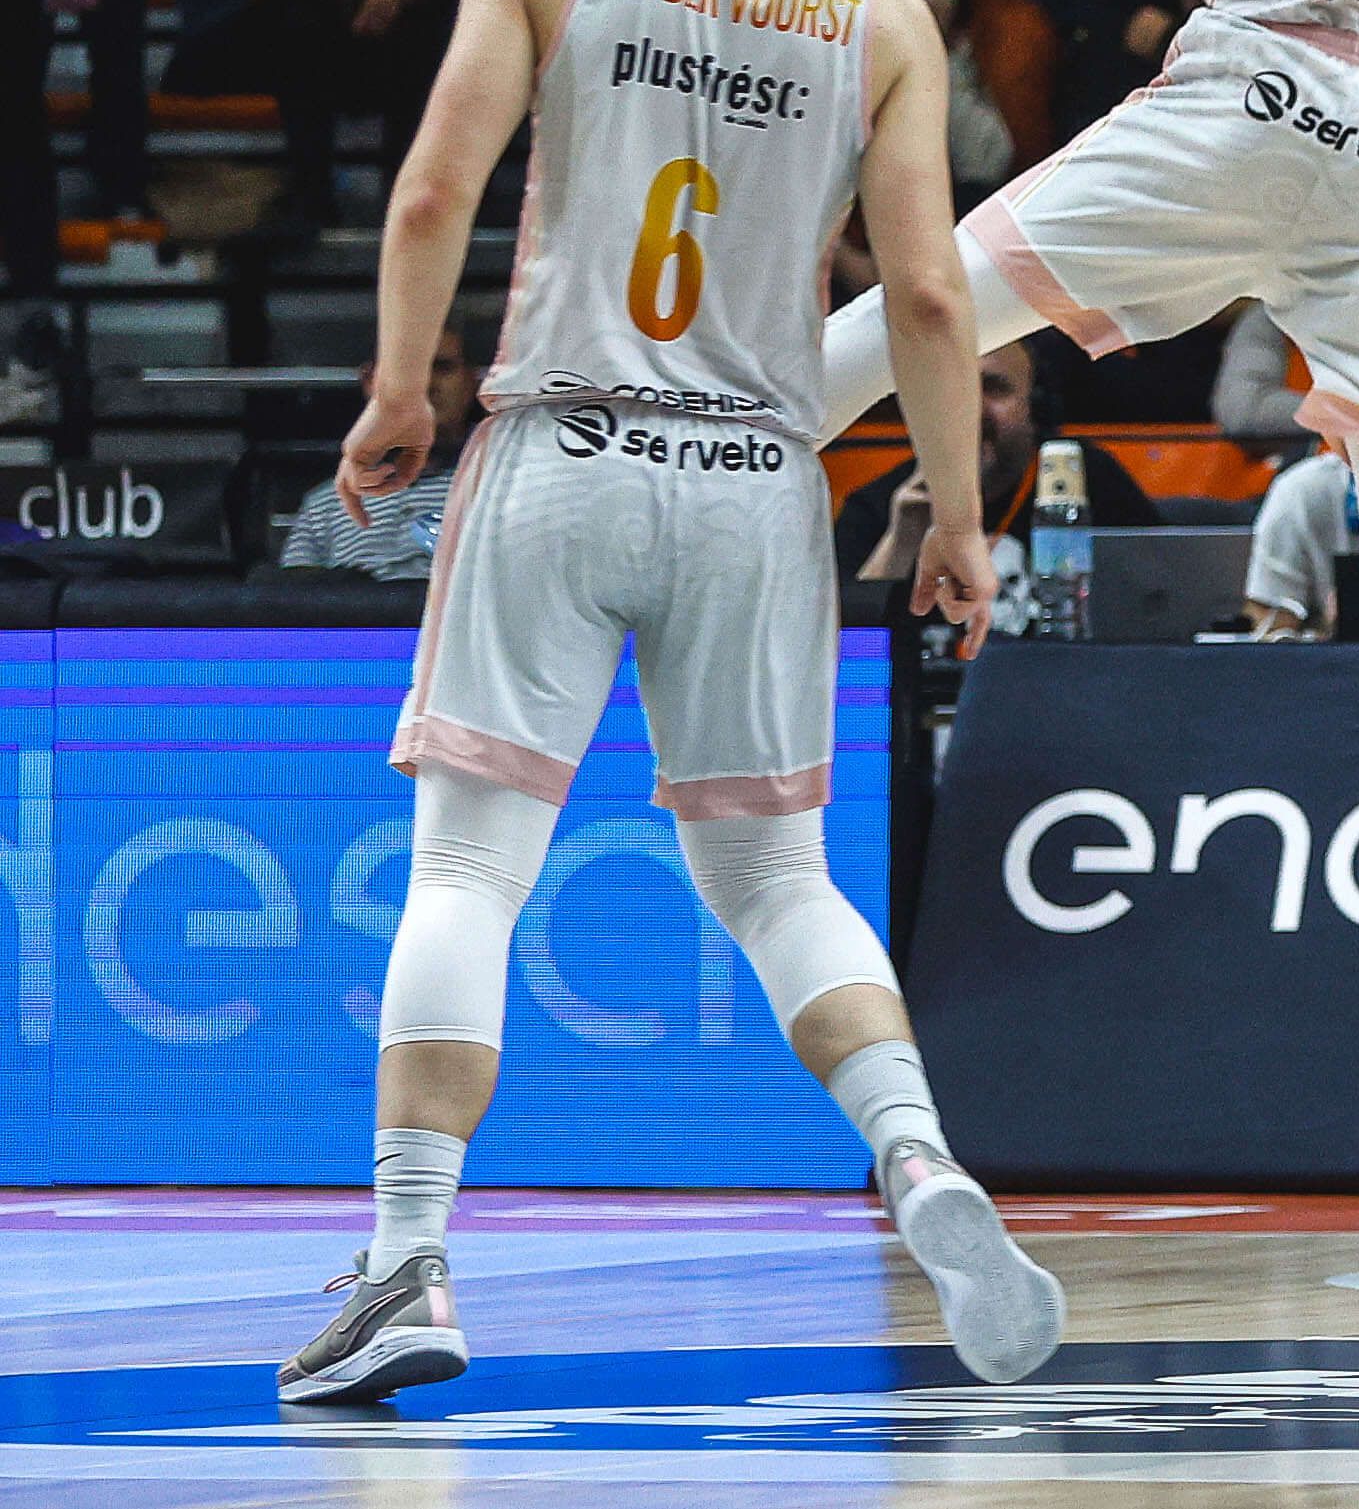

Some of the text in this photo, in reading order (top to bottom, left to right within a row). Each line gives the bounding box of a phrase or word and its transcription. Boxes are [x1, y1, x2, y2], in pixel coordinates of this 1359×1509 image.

[628, 157, 720, 342] 6
[621, 429, 783, 473] serveto
[19, 465, 164, 539] club
